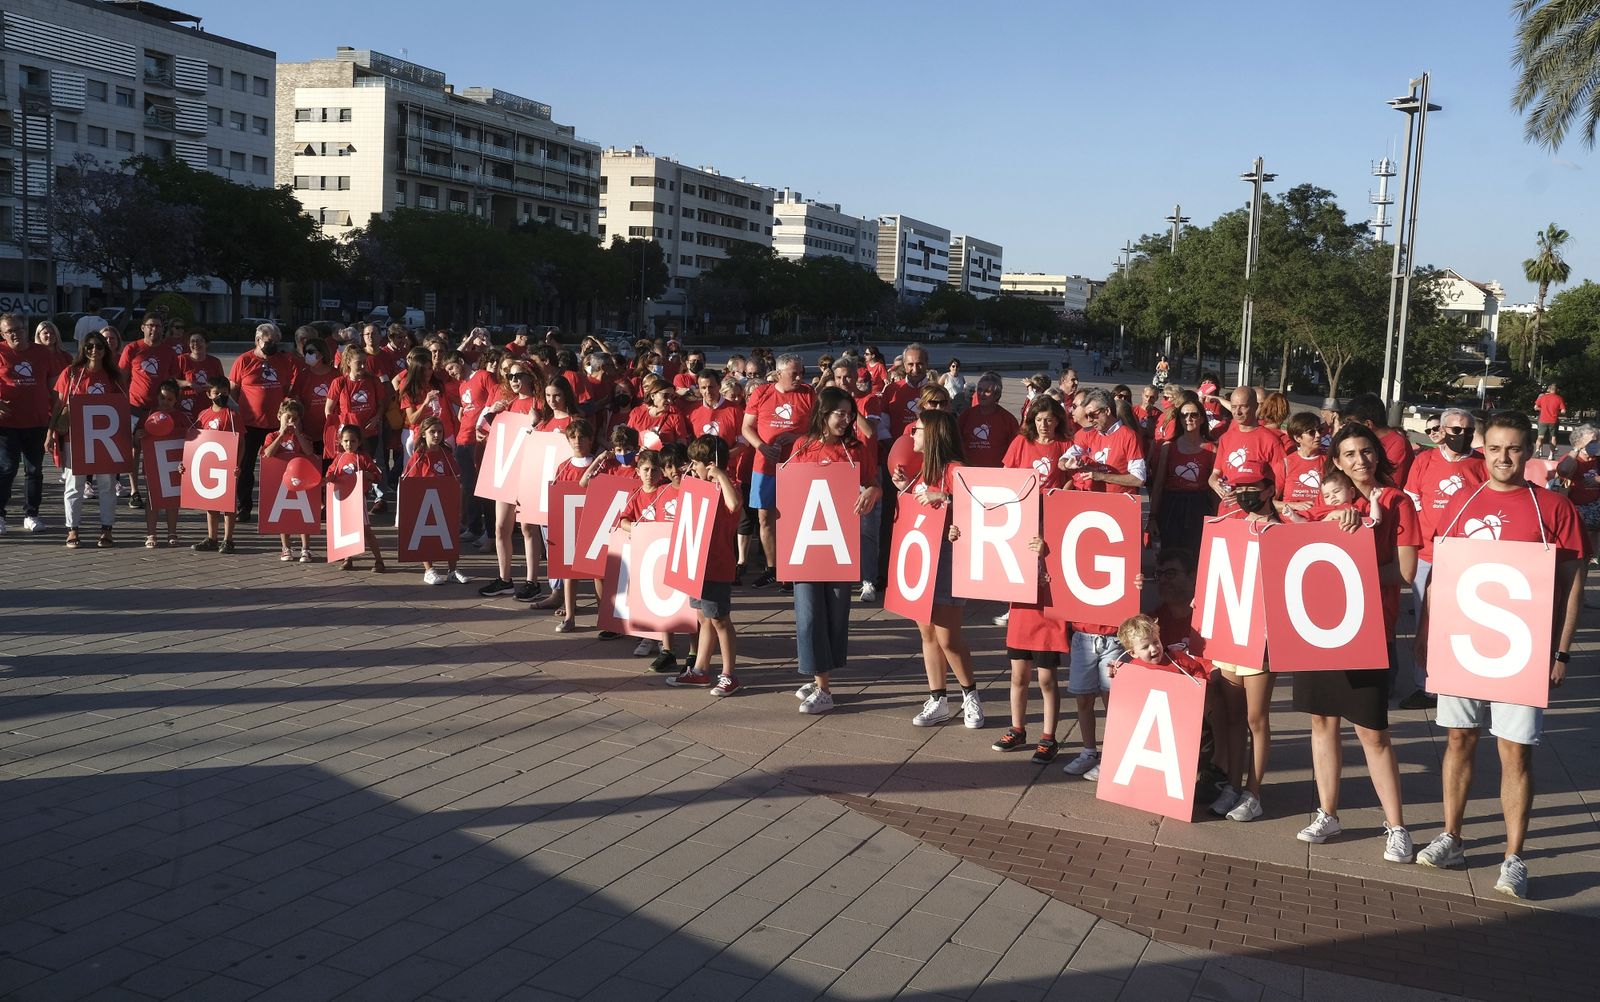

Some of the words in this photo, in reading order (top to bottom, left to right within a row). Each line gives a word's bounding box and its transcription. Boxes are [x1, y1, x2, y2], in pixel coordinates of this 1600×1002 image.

[82, 405, 125, 464] R
[154, 438, 184, 499] E
[190, 441, 228, 499] G
[493, 422, 529, 489] V
[332, 490, 361, 550] L
[407, 488, 454, 551] A
[670, 491, 710, 581] N
[788, 479, 852, 565] A
[896, 514, 931, 601] Ó
[969, 485, 1025, 584] R
[1061, 510, 1126, 606] G
[1201, 536, 1260, 647] N
[1284, 542, 1365, 648] O
[1450, 562, 1533, 679] S
[1112, 688, 1185, 800] A
